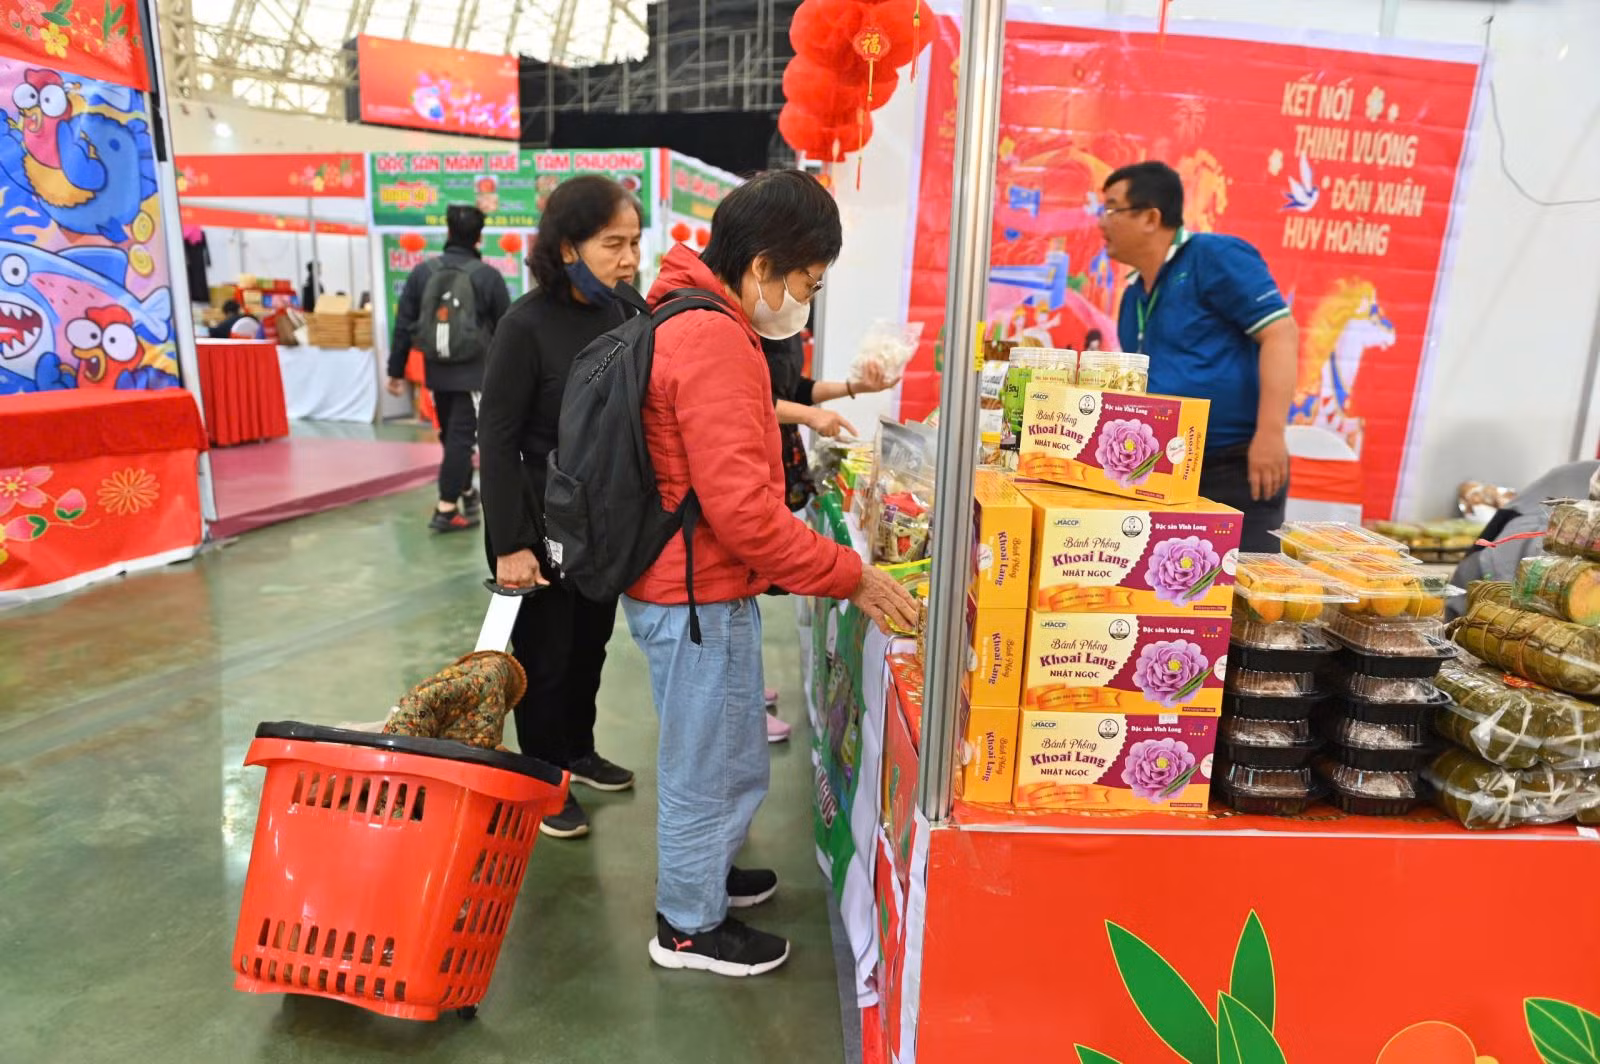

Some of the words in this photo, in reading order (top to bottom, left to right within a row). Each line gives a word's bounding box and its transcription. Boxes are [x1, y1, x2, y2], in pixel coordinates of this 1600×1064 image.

[1281, 73, 1318, 118] KẾT
[1318, 77, 1354, 121] NỐI
[1294, 124, 1349, 164] THỊNH
[1352, 129, 1419, 170] VƯỢNG
[1331, 174, 1373, 212] ĐÓN
[1373, 177, 1426, 217] XUÂN
[1282, 216, 1324, 249] HUY
[1324, 216, 1390, 256] HOÀNG
[1036, 410, 1054, 421] Bánh
[1028, 423, 1057, 436] Khoai
[1060, 425, 1084, 444] Lang
[1052, 441, 1071, 451] NGỌC
[998, 531, 1008, 561] Khoai
[1064, 536, 1089, 549] Bánh
[1052, 551, 1094, 567] Khoai
[1098, 551, 1129, 568] Lang
[995, 564, 1008, 586] Lang
[1087, 570, 1112, 578] NGỌC
[992, 632, 1002, 660] Khoai
[1050, 638, 1077, 650] Bánh
[1040, 652, 1081, 667] Khoai
[1086, 652, 1117, 670] Lang
[988, 663, 1002, 685] Lang
[1075, 670, 1100, 679] NGỌC
[986, 731, 996, 759] Khoai
[1042, 738, 1067, 749] Bánh
[1030, 751, 1072, 766] Khoai
[1076, 751, 1106, 768] Lang
[982, 761, 995, 781] Lang
[1065, 769, 1089, 777] NGỌC
